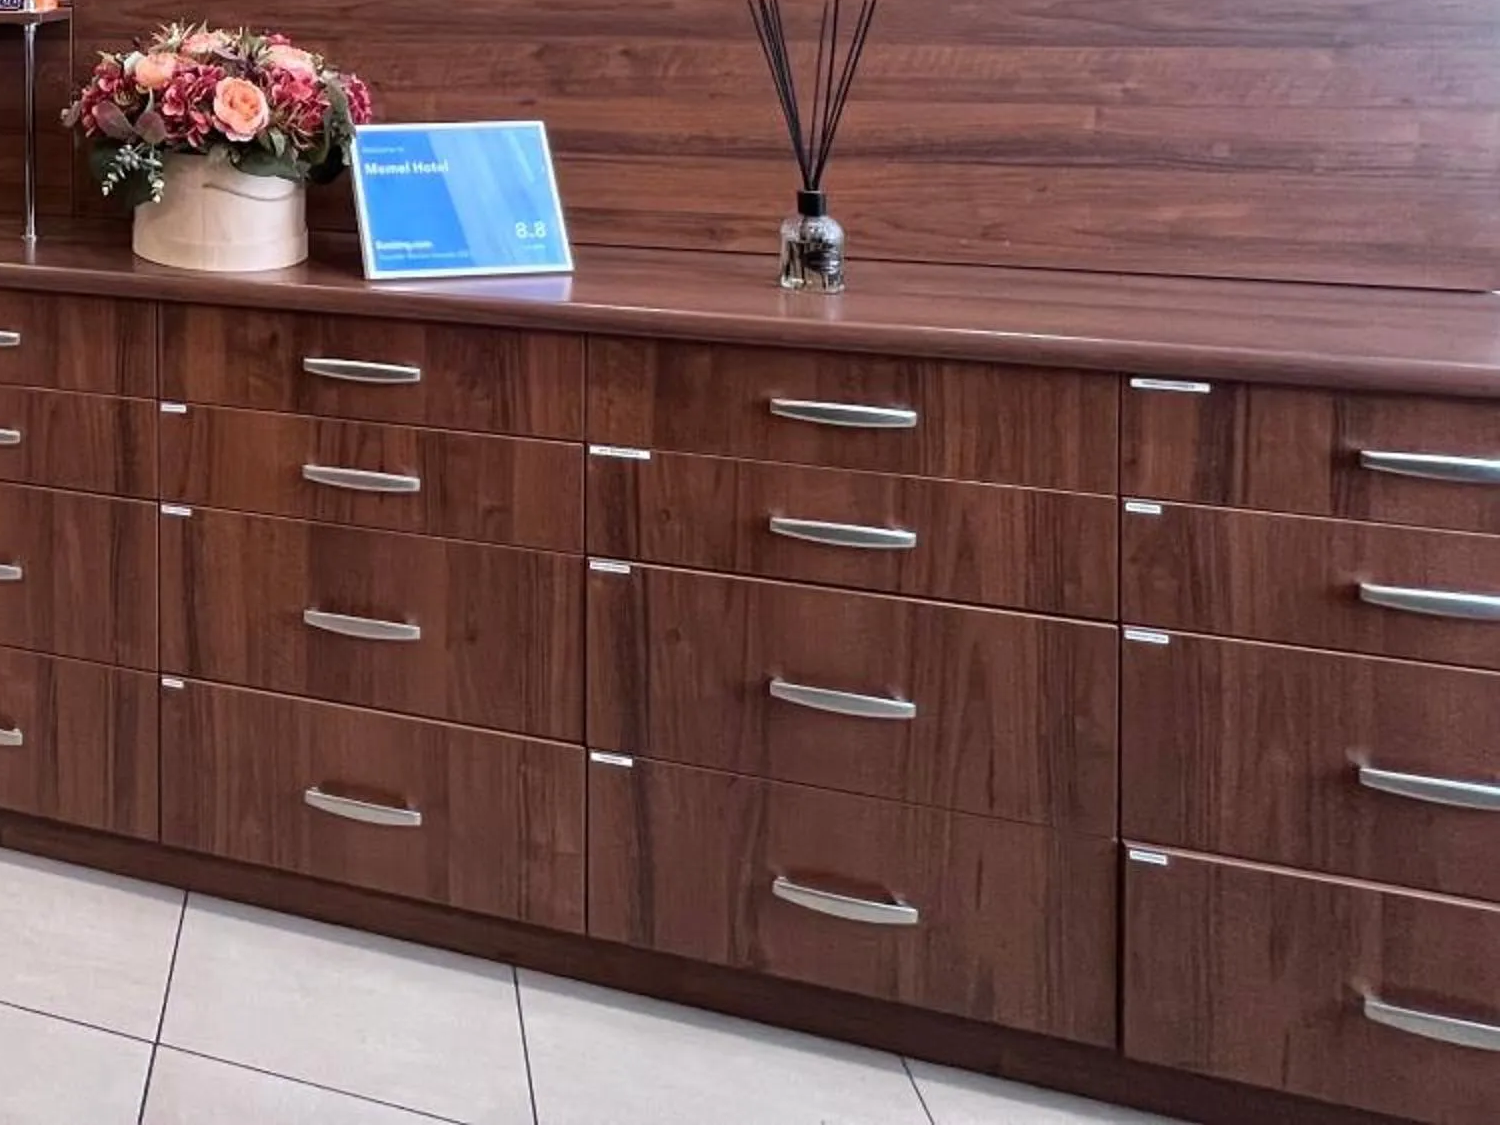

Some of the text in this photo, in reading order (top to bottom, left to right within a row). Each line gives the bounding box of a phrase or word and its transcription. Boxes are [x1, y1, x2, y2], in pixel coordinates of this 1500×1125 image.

[364, 159, 449, 175] Memel Hotel
[515, 220, 547, 239] 8.8
